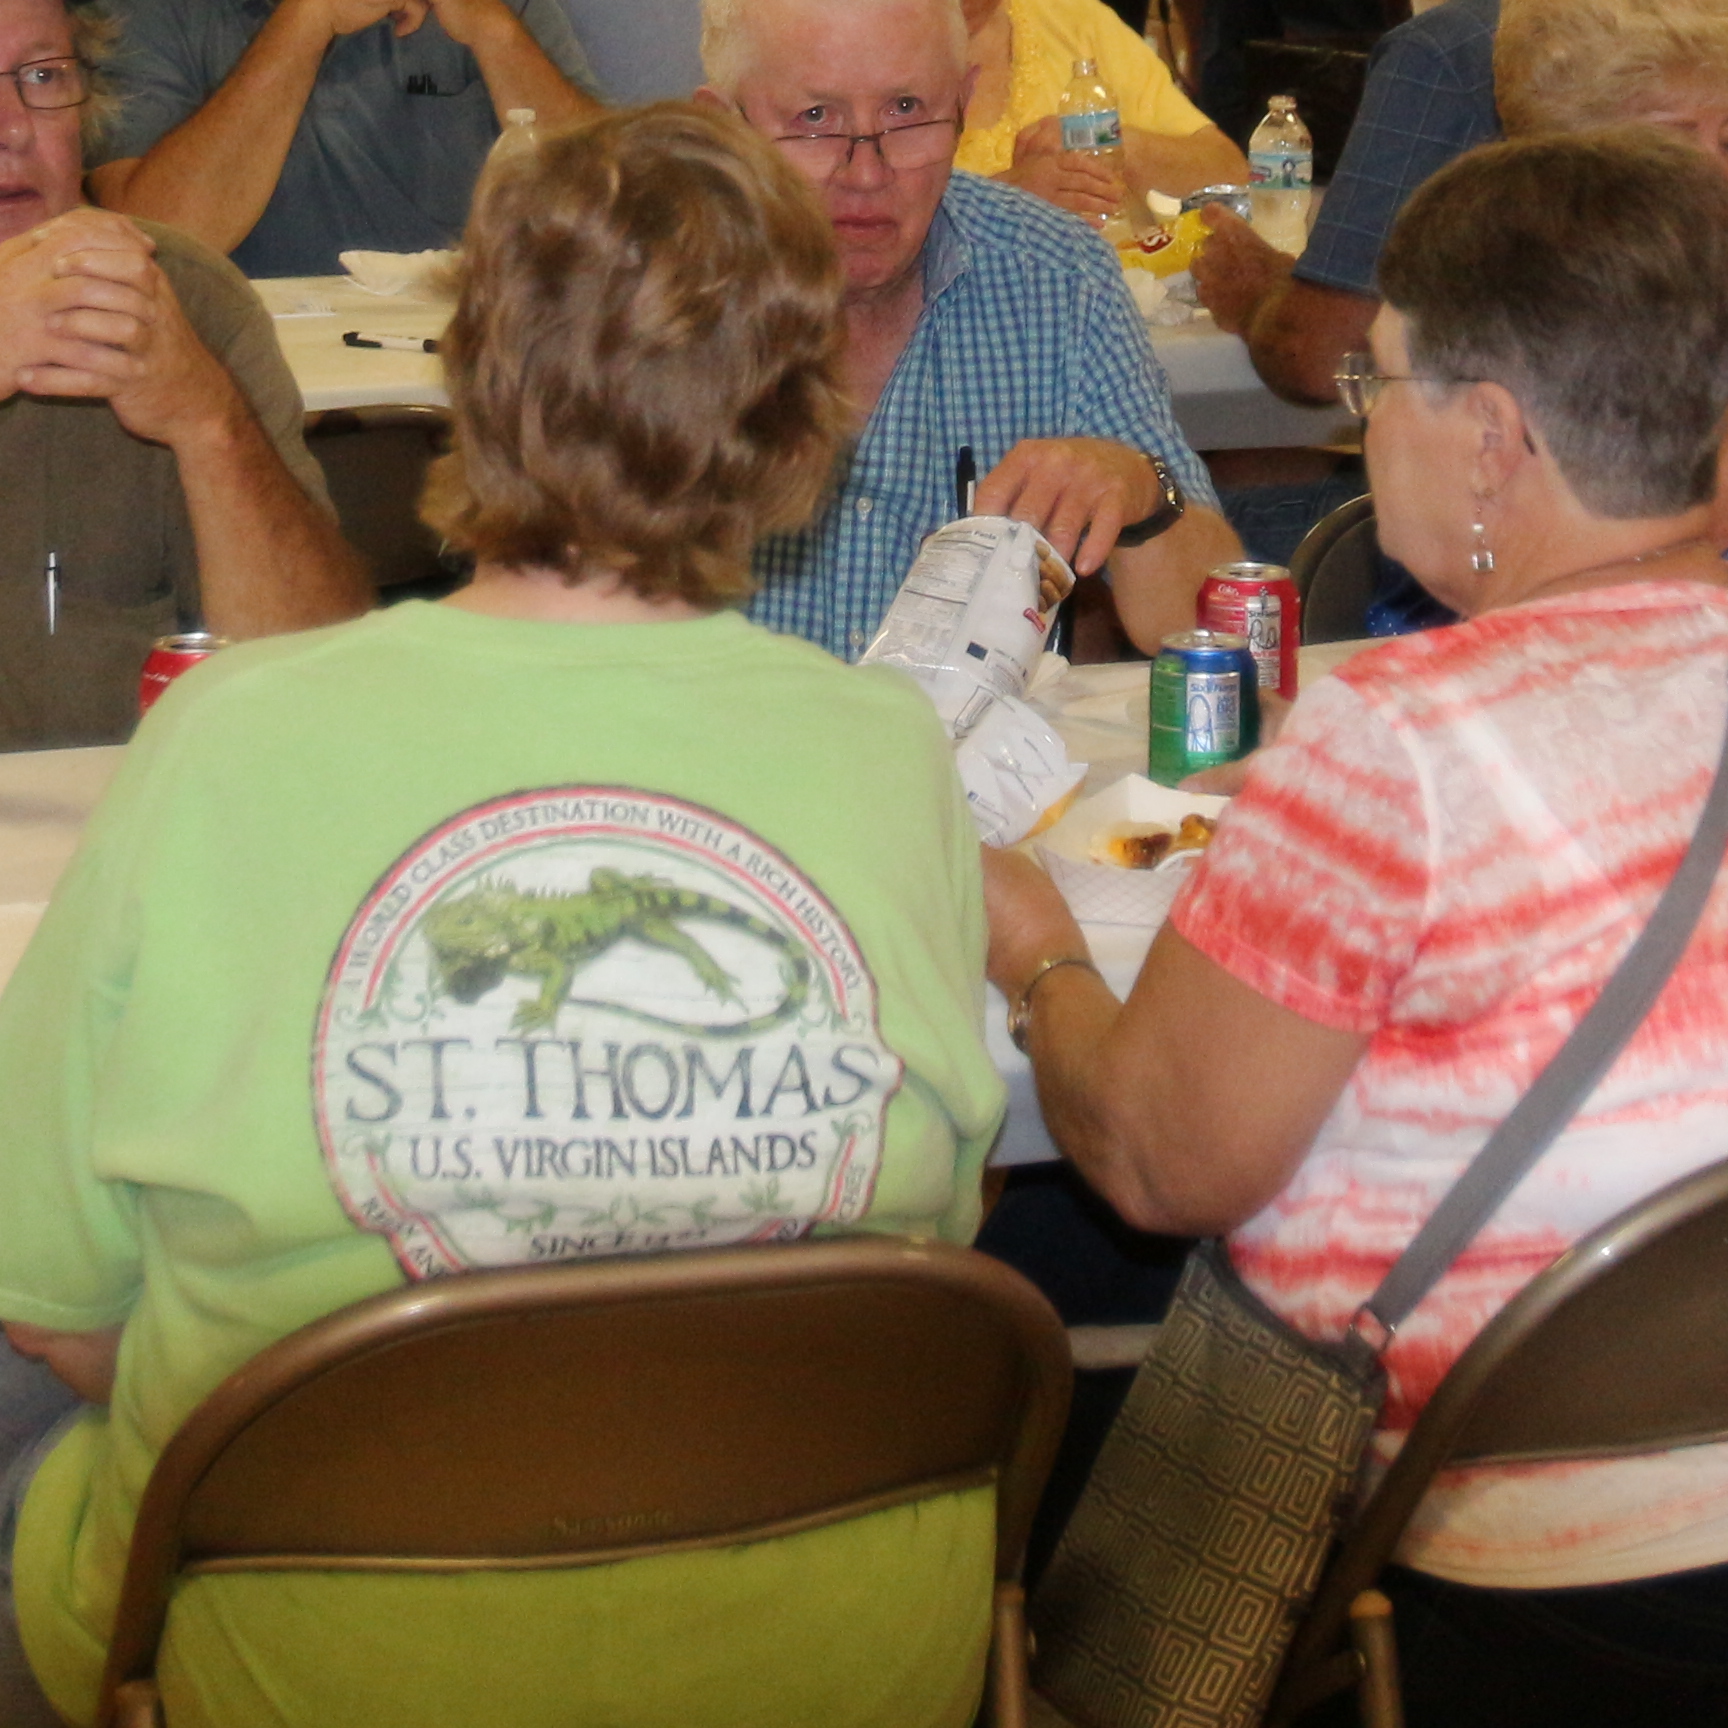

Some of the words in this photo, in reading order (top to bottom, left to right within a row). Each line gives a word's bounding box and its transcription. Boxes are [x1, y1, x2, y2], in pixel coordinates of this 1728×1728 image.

[348, 883, 411, 967] WORLD
[411, 828, 477, 884] CLASS
[480, 801, 649, 841] DESTINATION
[658, 810, 724, 850] WITH
[727, 842, 744, 862] A
[746, 853, 798, 900] RICH
[345, 1038, 477, 1122] ST.
[495, 1038, 883, 1122] THOMAS
[409, 1135, 482, 1180] U.S.
[494, 1135, 638, 1180] VIRGIN
[646, 1130, 819, 1177] ISLANDS
